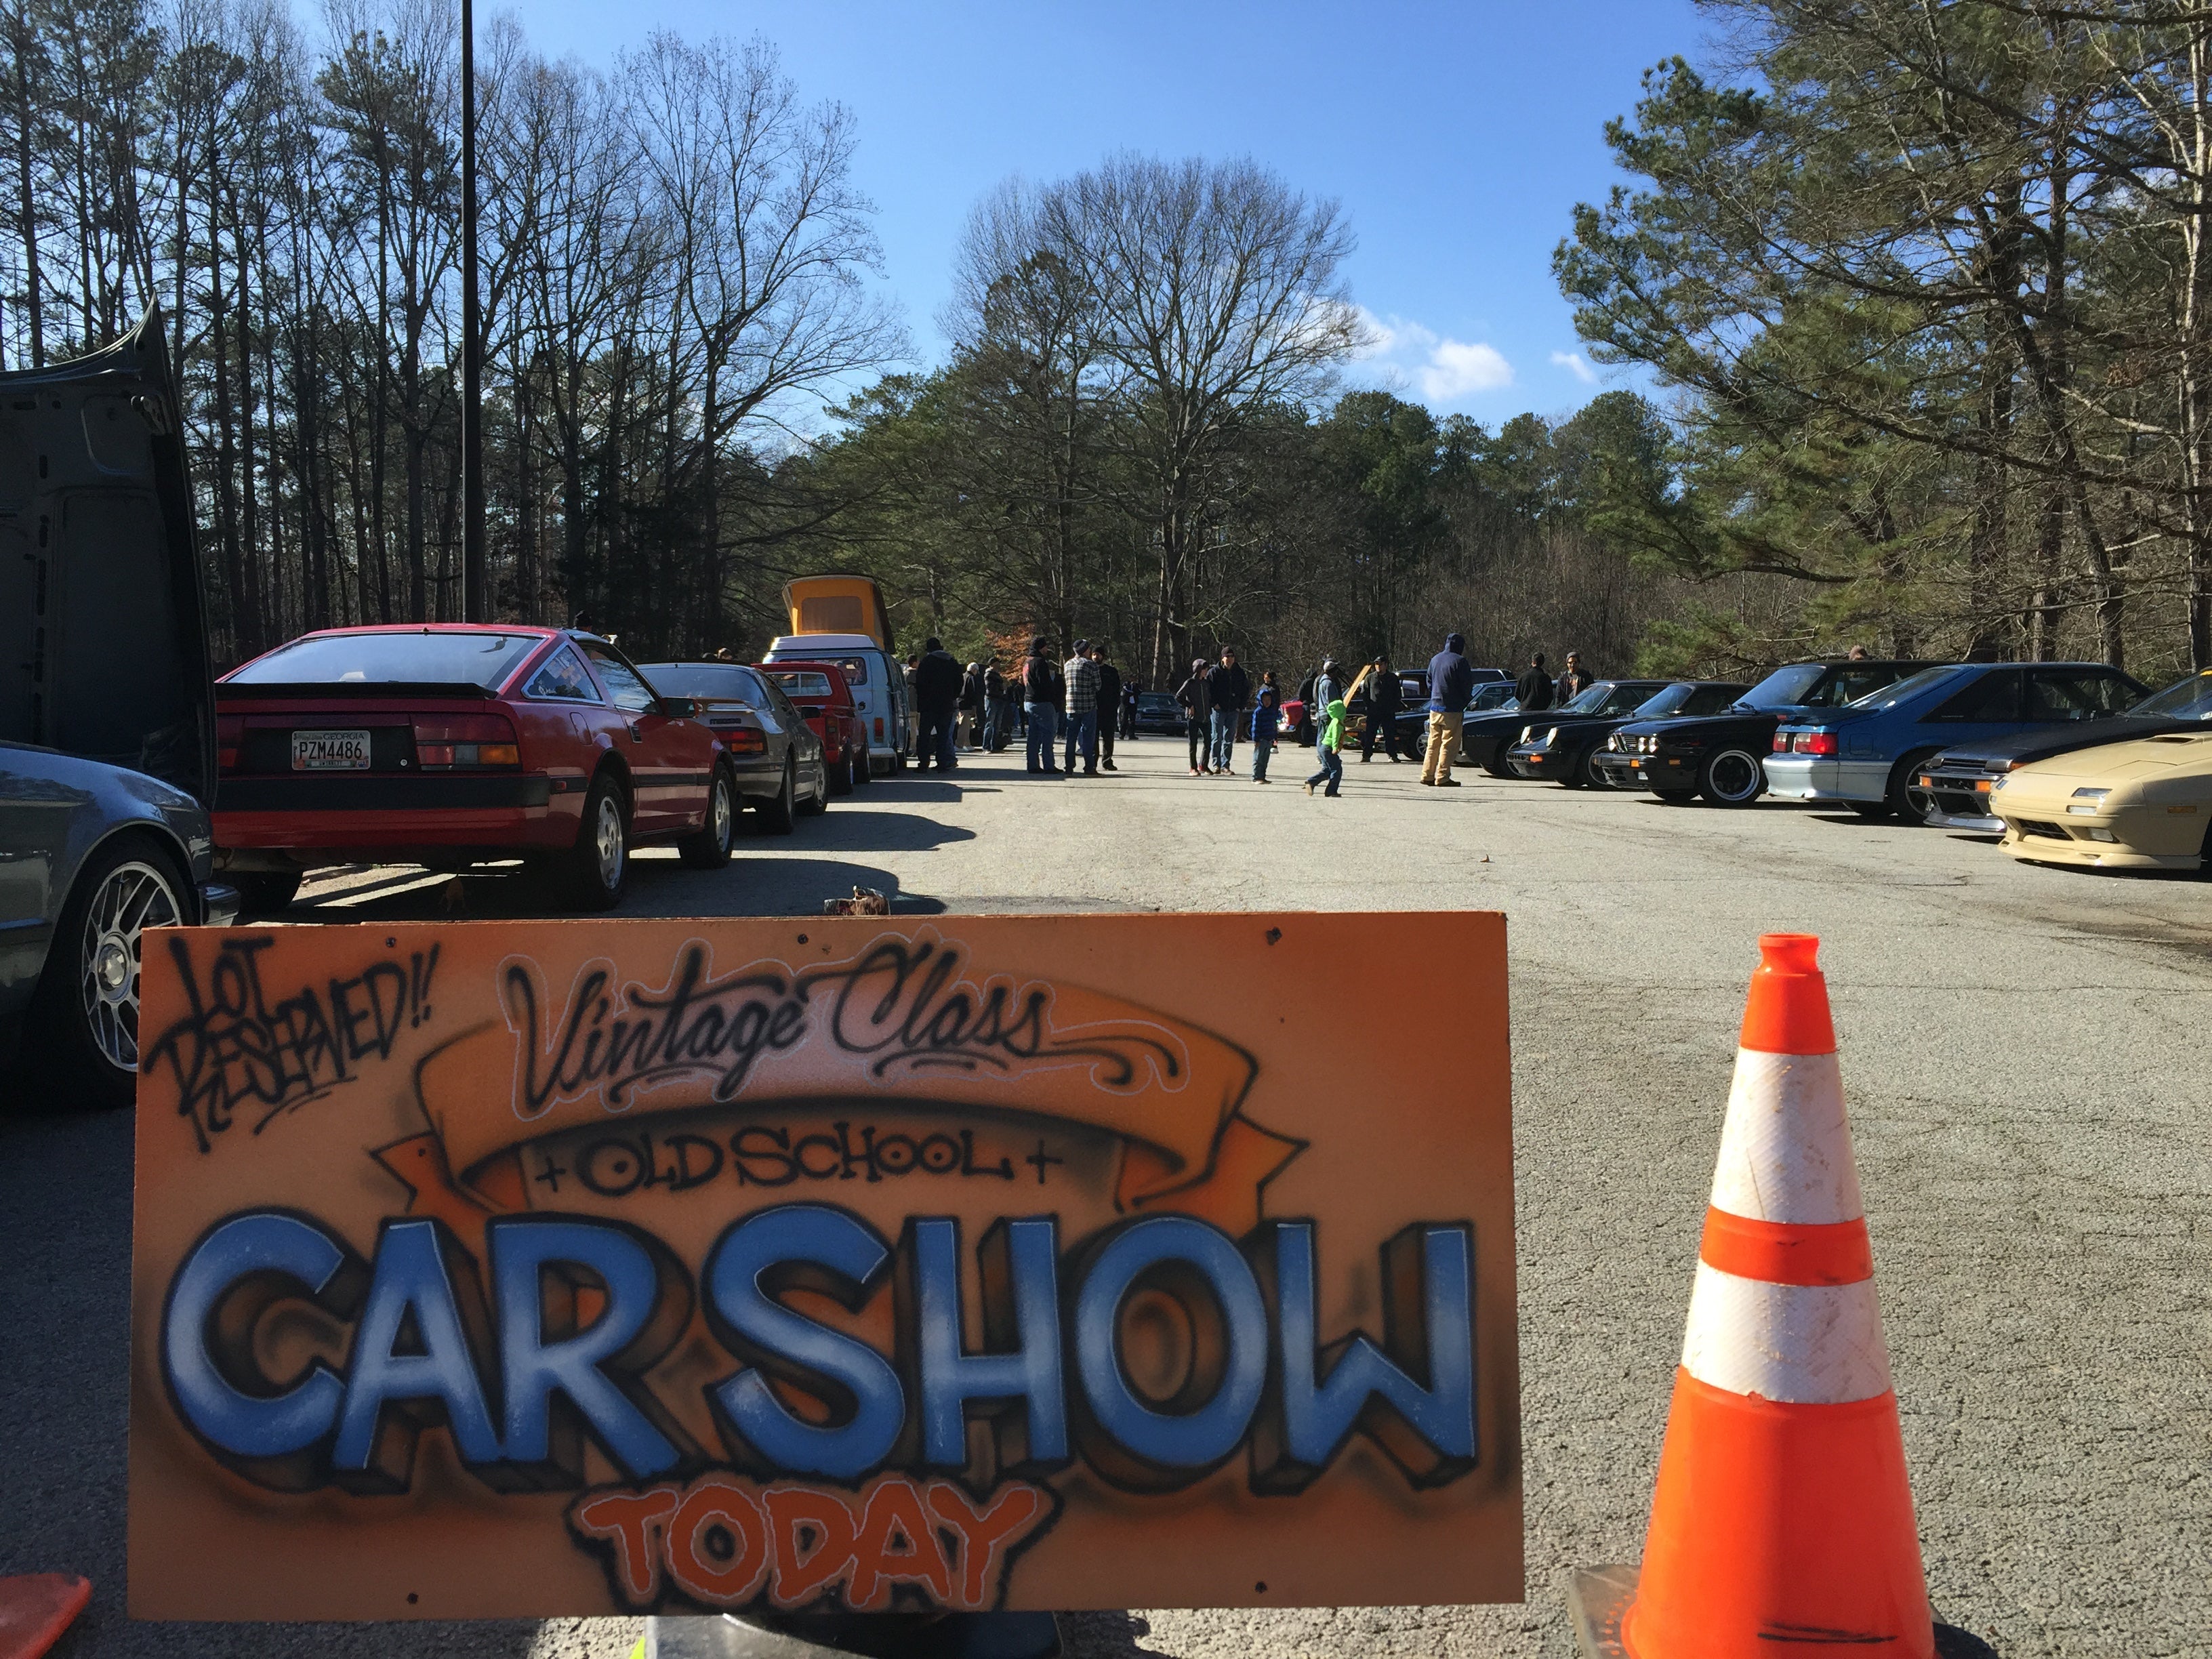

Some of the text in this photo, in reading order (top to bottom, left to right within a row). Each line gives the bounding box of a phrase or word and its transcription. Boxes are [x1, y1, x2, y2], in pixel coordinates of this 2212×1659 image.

[299, 741, 362, 760] PZM4486
[505, 941, 1054, 1113] Vintage Class
[578, 1120, 1015, 1197] OLD SCHOOL
[581, 1480, 1038, 1607] TODAY
